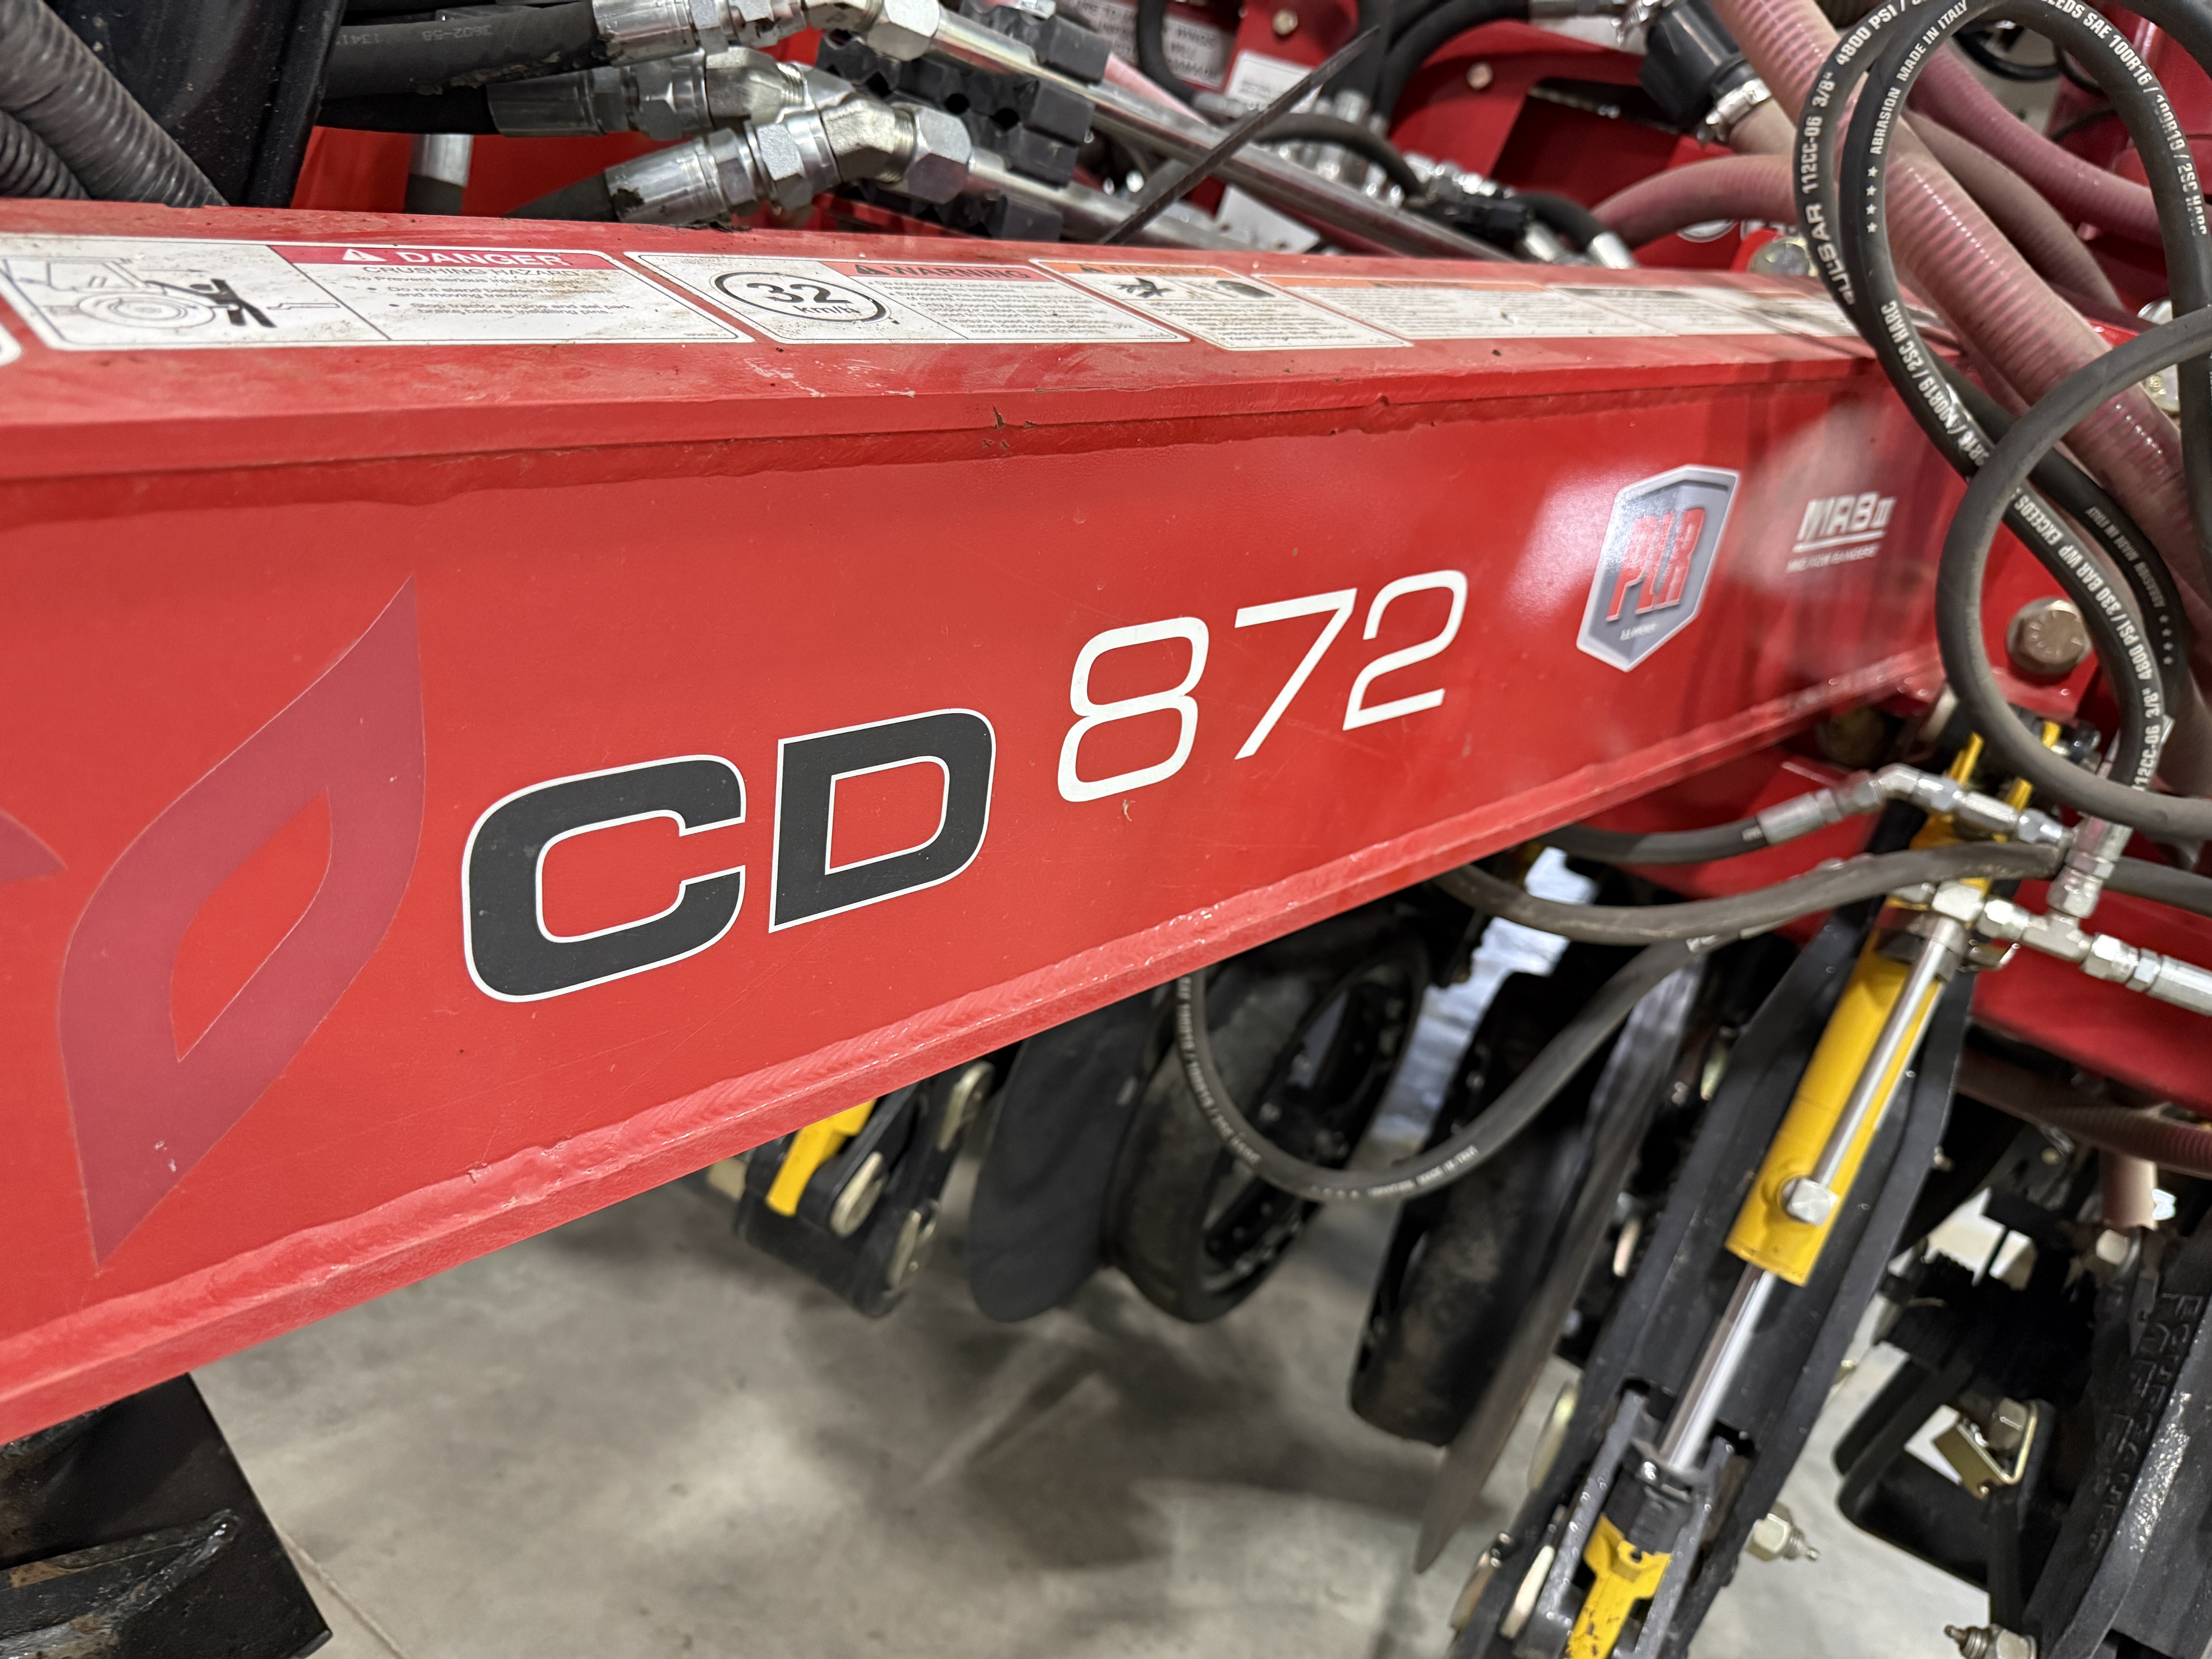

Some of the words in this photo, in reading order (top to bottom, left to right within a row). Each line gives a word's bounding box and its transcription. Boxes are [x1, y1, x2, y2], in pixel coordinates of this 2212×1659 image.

[1870, 87, 1901, 155] ABRASION
[1896, 43, 1927, 82] MADE
[1922, 26, 1939, 45] IN
[1937, 0, 1968, 29] ITALY
[1801, 116, 1823, 194] 112CC-06
[1812, 71, 1836, 108] 3/8"
[1834, 27, 1872, 65] 4800
[1868, 4, 1898, 30] PSI
[2083, 13, 2112, 39] SAE
[2108, 35, 2152, 86] 100R16
[2177, 163, 2198, 193] 2SC
[362, 266, 488, 275] CRUSHING
[395, 251, 573, 266] DANGER
[882, 266, 1032, 279] WARNING
[746, 282, 854, 304] 32
[793, 305, 862, 315] km/h
[1881, 300, 1911, 343] HARC
[1898, 340, 1924, 372] 2SC
[2014, 495, 2065, 546] EXCEEDS
[2057, 544, 2083, 569] WP
[2075, 561, 2104, 592] BAR
[2094, 587, 2122, 616] 330
[2116, 620, 2140, 647] PSI
[2128, 643, 2152, 680] 4800
[2142, 688, 2161, 718] 3/8"
[461, 707, 998, 1003] CD
[1057, 568, 1468, 803] 872
